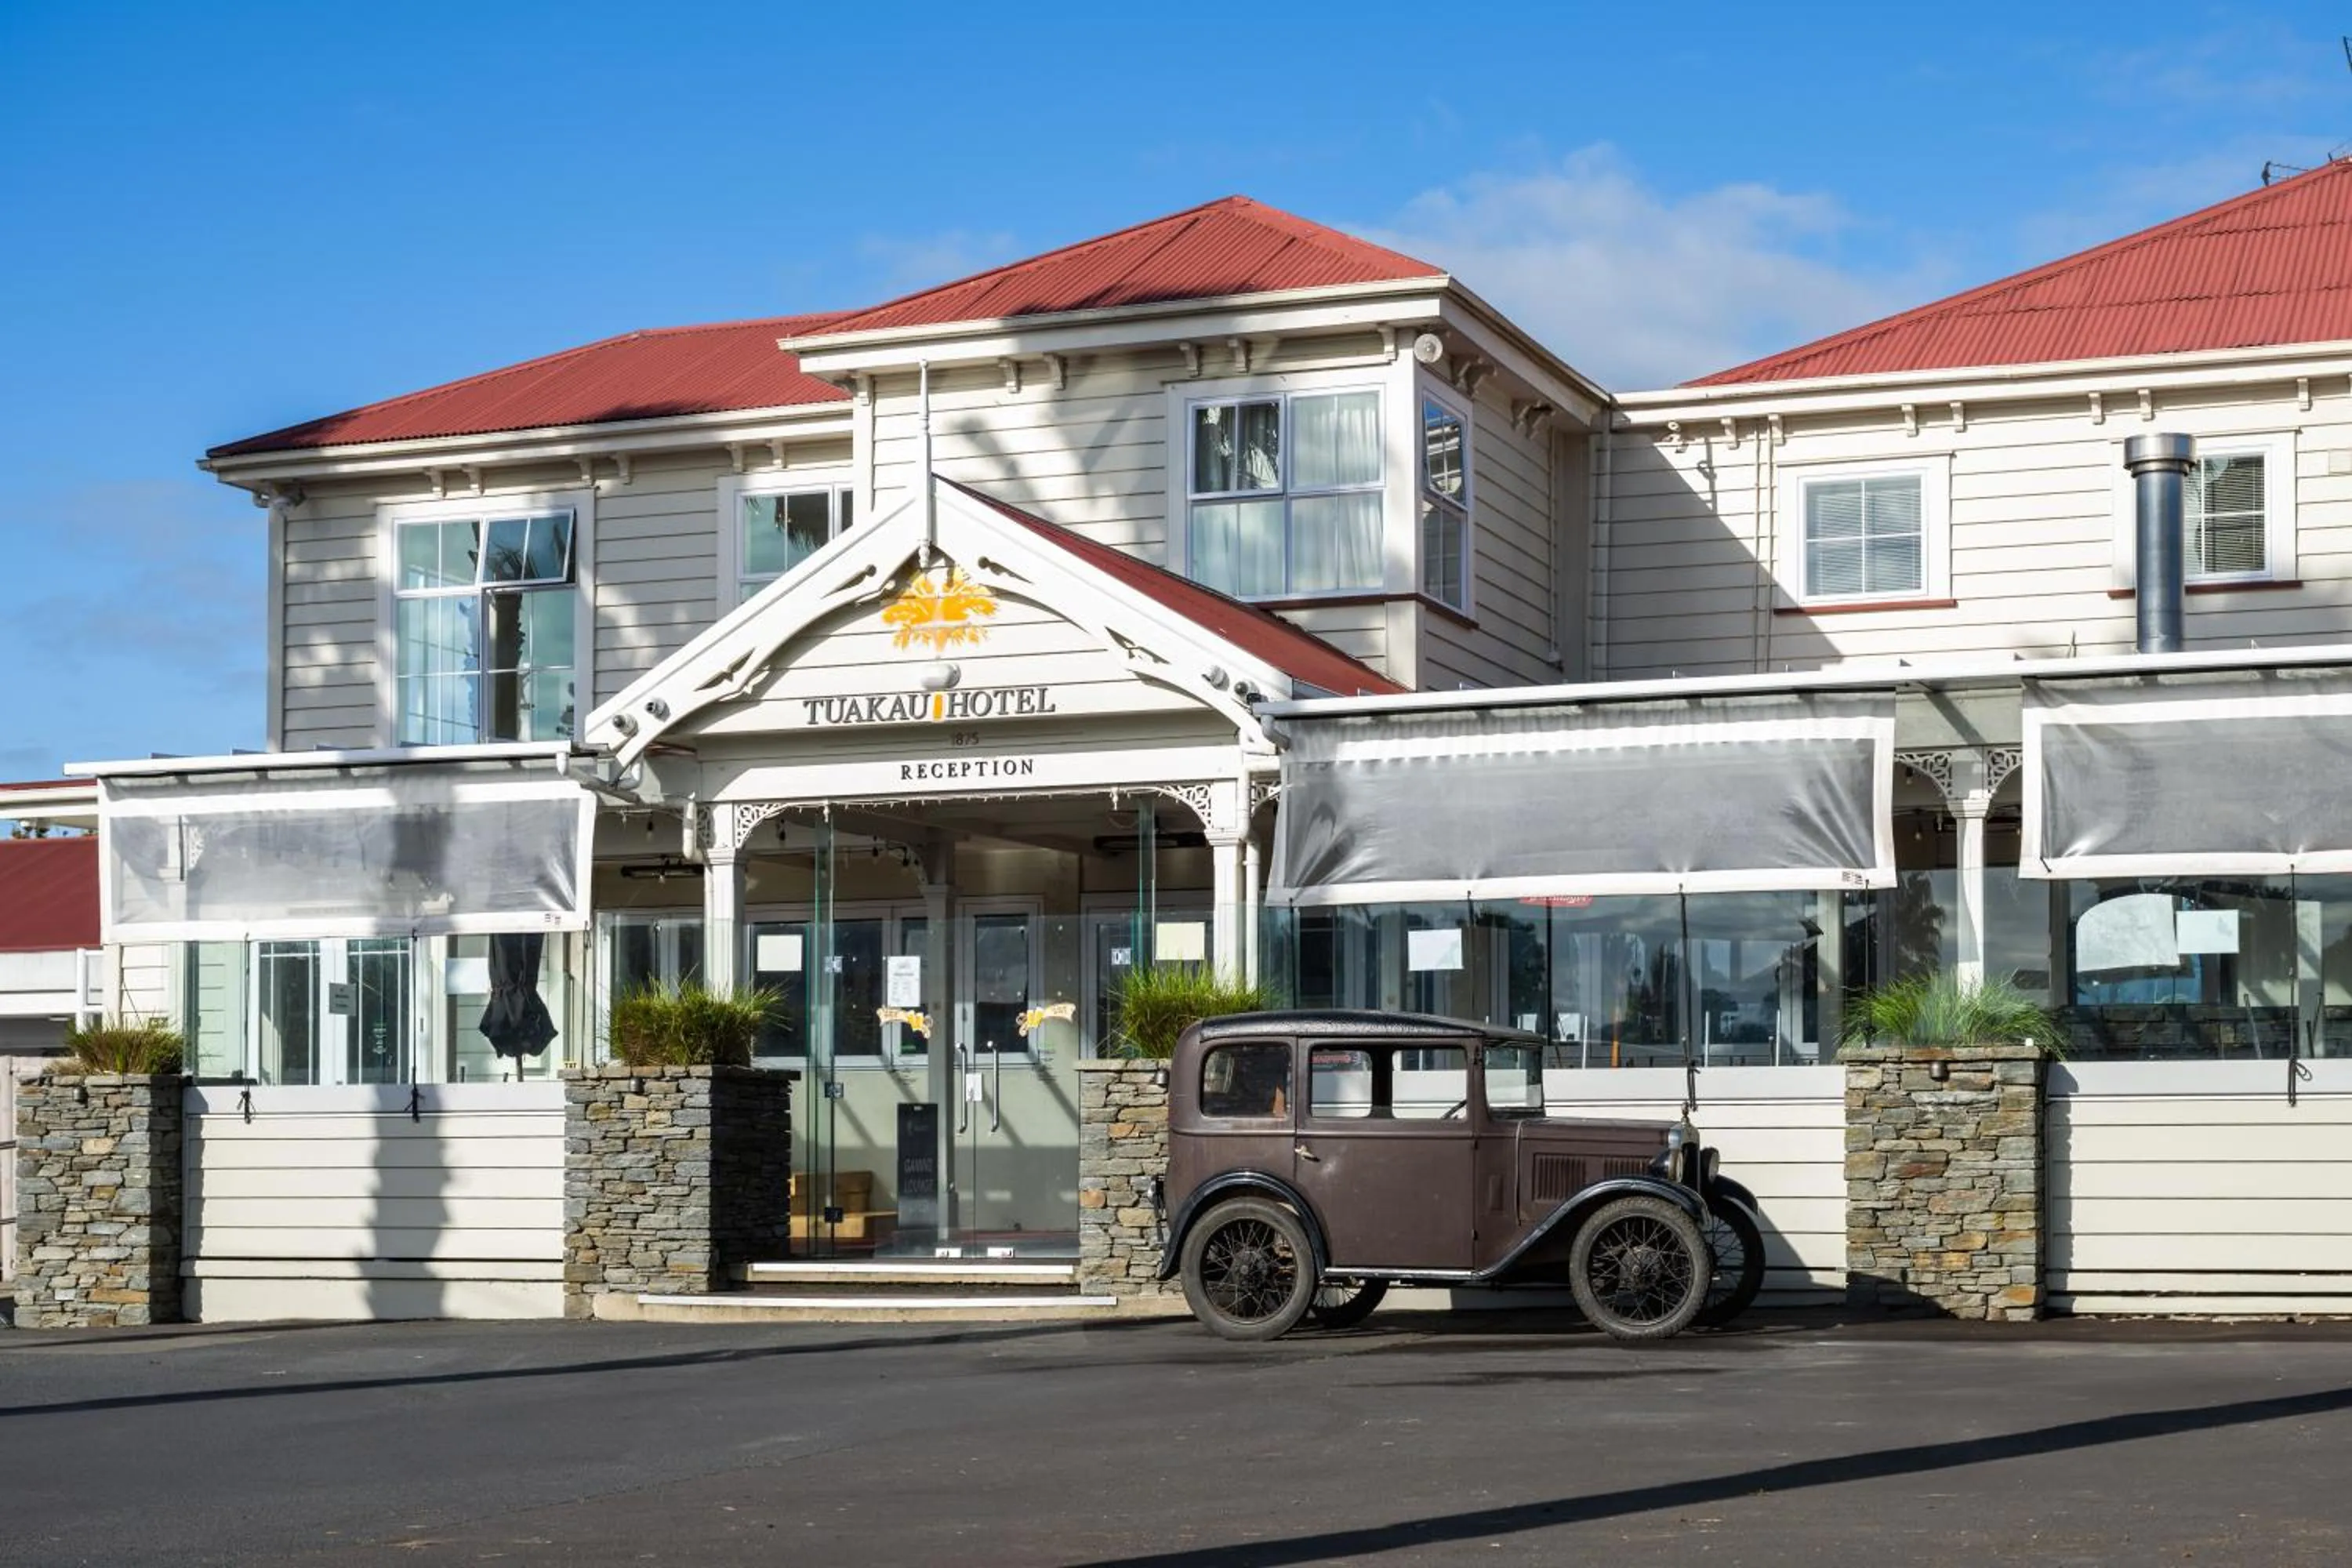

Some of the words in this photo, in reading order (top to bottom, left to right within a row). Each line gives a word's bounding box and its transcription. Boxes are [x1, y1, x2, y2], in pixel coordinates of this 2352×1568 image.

[803, 693, 931, 724] TUAKAU
[946, 688, 1056, 717] HOTEL
[901, 759, 1033, 780] RECEPTION
